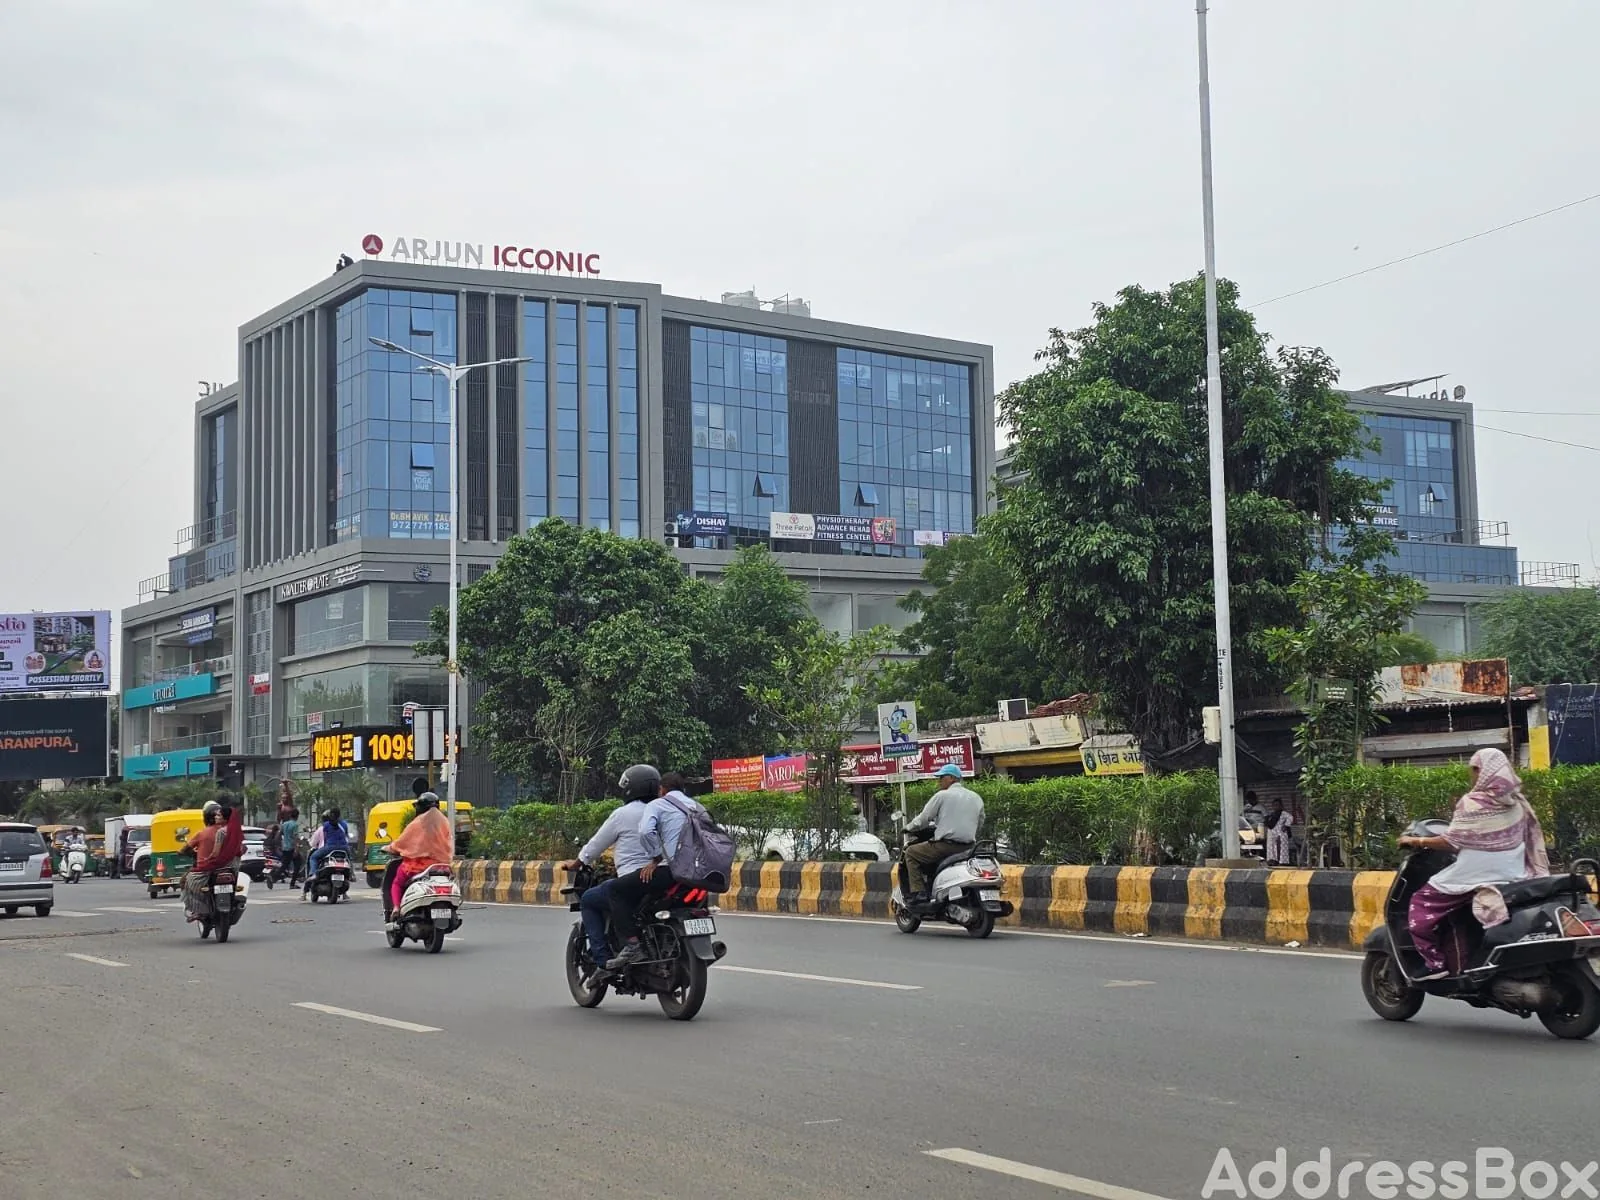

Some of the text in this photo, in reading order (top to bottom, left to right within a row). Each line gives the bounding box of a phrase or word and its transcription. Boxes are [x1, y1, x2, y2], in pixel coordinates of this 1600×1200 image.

[390, 237, 601, 275] ARJUN ICCONIC
[696, 517, 727, 526] DISHAY
[816, 515, 871, 525] PHYSIOTHERAPY
[816, 524, 871, 533] ADVANCE REHAB
[816, 531, 844, 539] FITNESS
[28, 675, 70, 684] POSSESSION
[70, 673, 101, 683] SHORTLY
